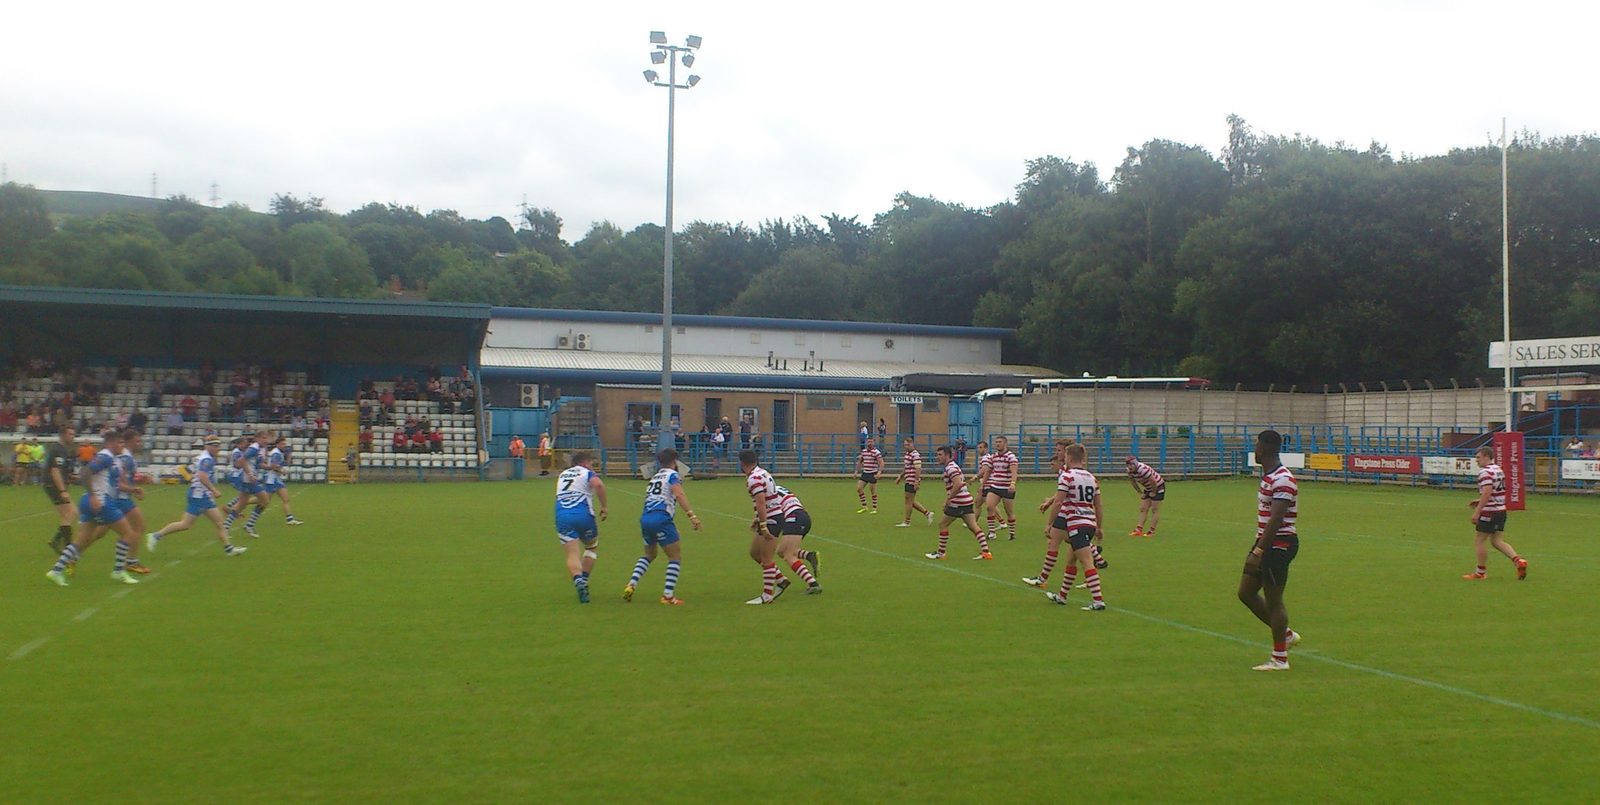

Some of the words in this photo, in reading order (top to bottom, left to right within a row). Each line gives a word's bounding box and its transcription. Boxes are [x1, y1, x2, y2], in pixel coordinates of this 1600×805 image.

[1516, 344, 1567, 361] SALES
[1570, 343, 1600, 359] SER
[1510, 441, 1519, 462] Press
[1354, 458, 1381, 470] Kingstone
[1381, 459, 1395, 468] Press
[1396, 459, 1411, 469] Cider
[562, 479, 574, 491] 7
[646, 481, 663, 495] 28
[1511, 464, 1520, 502] Kingstone
[1078, 484, 1094, 502] 18
